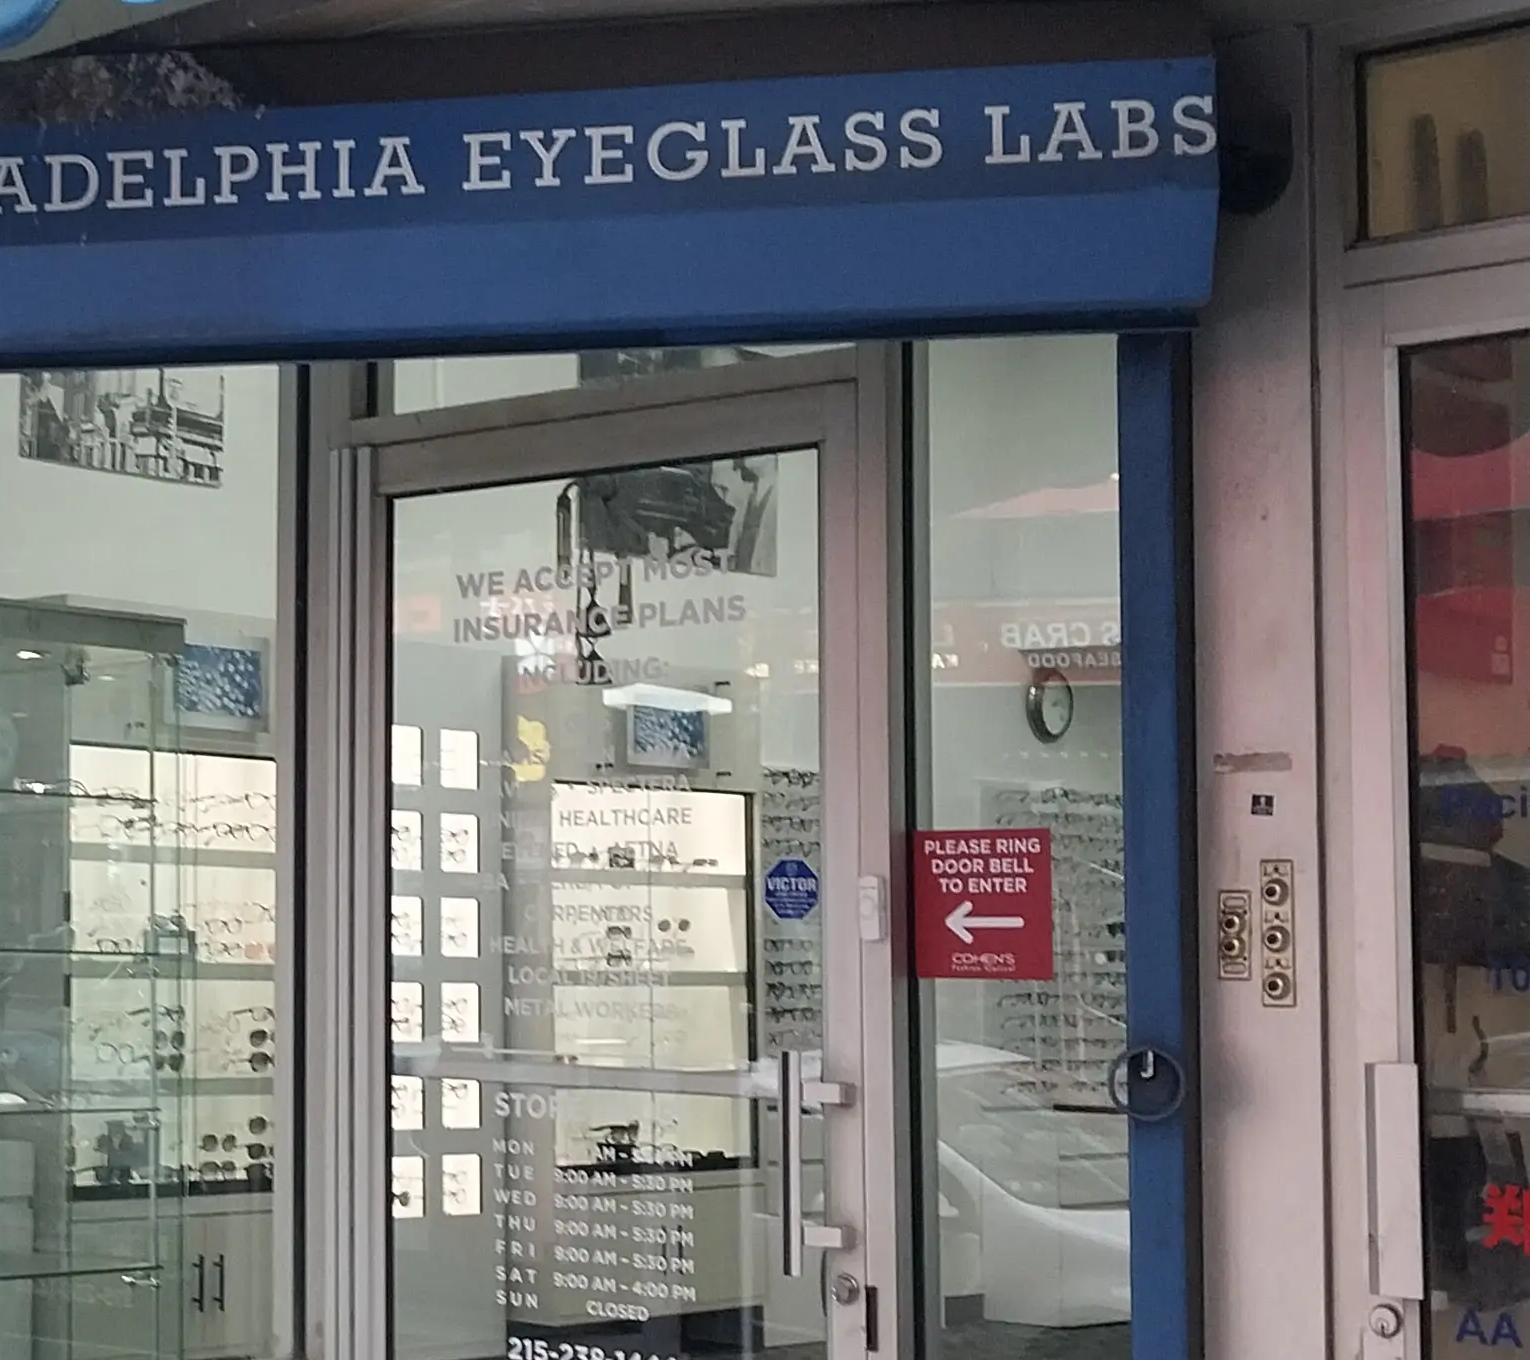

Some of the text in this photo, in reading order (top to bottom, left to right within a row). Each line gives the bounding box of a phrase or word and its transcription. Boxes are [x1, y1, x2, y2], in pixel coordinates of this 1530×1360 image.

[463, 121, 943, 191] EYEGLASS
[983, 96, 1217, 165] LABS
[456, 548, 736, 598] WE ACCEPT MOST
[454, 605, 631, 643] INSURANCE
[639, 594, 747, 628] PLANS
[516, 657, 669, 686] NCLUDING:
[559, 807, 693, 827] HEALTHCARE
[924, 838, 1041, 855] PLEASE RING
[931, 857, 1034, 874] DOOR BELL
[767, 876, 816, 892] VICTOR
[938, 877, 1027, 893] TO ENTER
[524, 904, 653, 923] CRPENTERS
[508, 967, 572, 986] LOCAL
[493, 1138, 534, 1155] MON
[494, 1165, 534, 1181] TUE
[593, 1171, 616, 1188] AM
[670, 1177, 693, 1194] PM
[493, 1189, 537, 1206] WED
[592, 1196, 616, 1214] AM
[670, 1202, 694, 1220] PM
[494, 1214, 536, 1232] THU
[592, 1222, 617, 1240] AM
[670, 1228, 694, 1247] PM
[495, 1240, 536, 1258] FRI
[592, 1248, 617, 1267] AM
[671, 1256, 695, 1274] PM
[495, 1266, 538, 1284] SAT
[592, 1275, 617, 1293] AM
[672, 1282, 697, 1302] PM
[496, 1290, 650, 1322] SUN CLOSED
